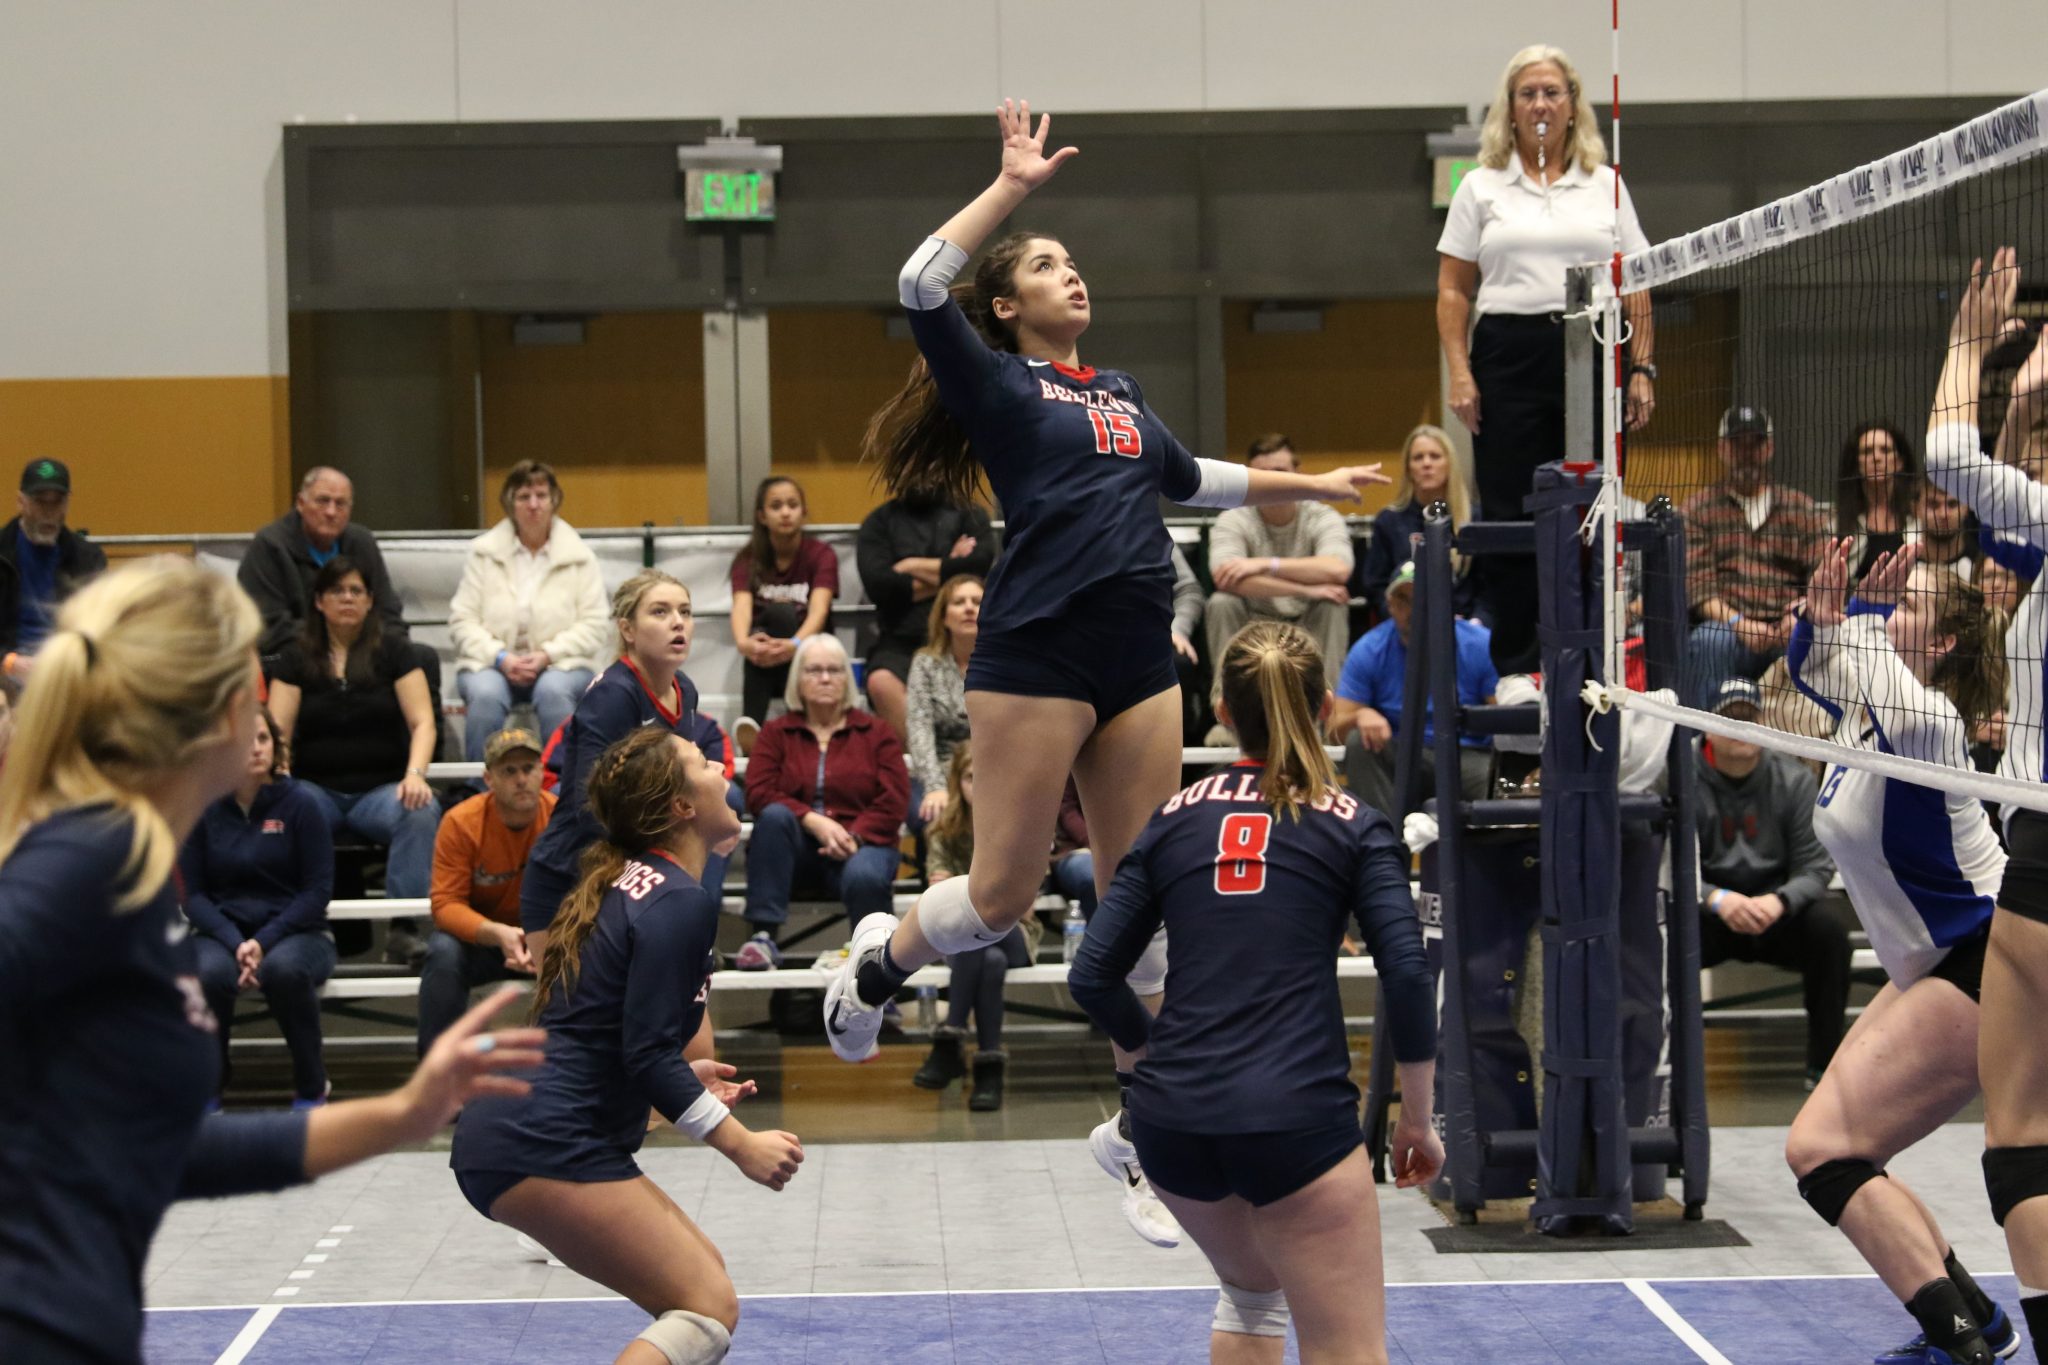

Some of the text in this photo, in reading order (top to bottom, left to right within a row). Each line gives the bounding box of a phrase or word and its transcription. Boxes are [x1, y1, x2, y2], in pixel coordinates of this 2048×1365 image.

[703, 173, 764, 215] EXIT
[1087, 408, 1143, 459] 15
[1214, 812, 1272, 895] 8
